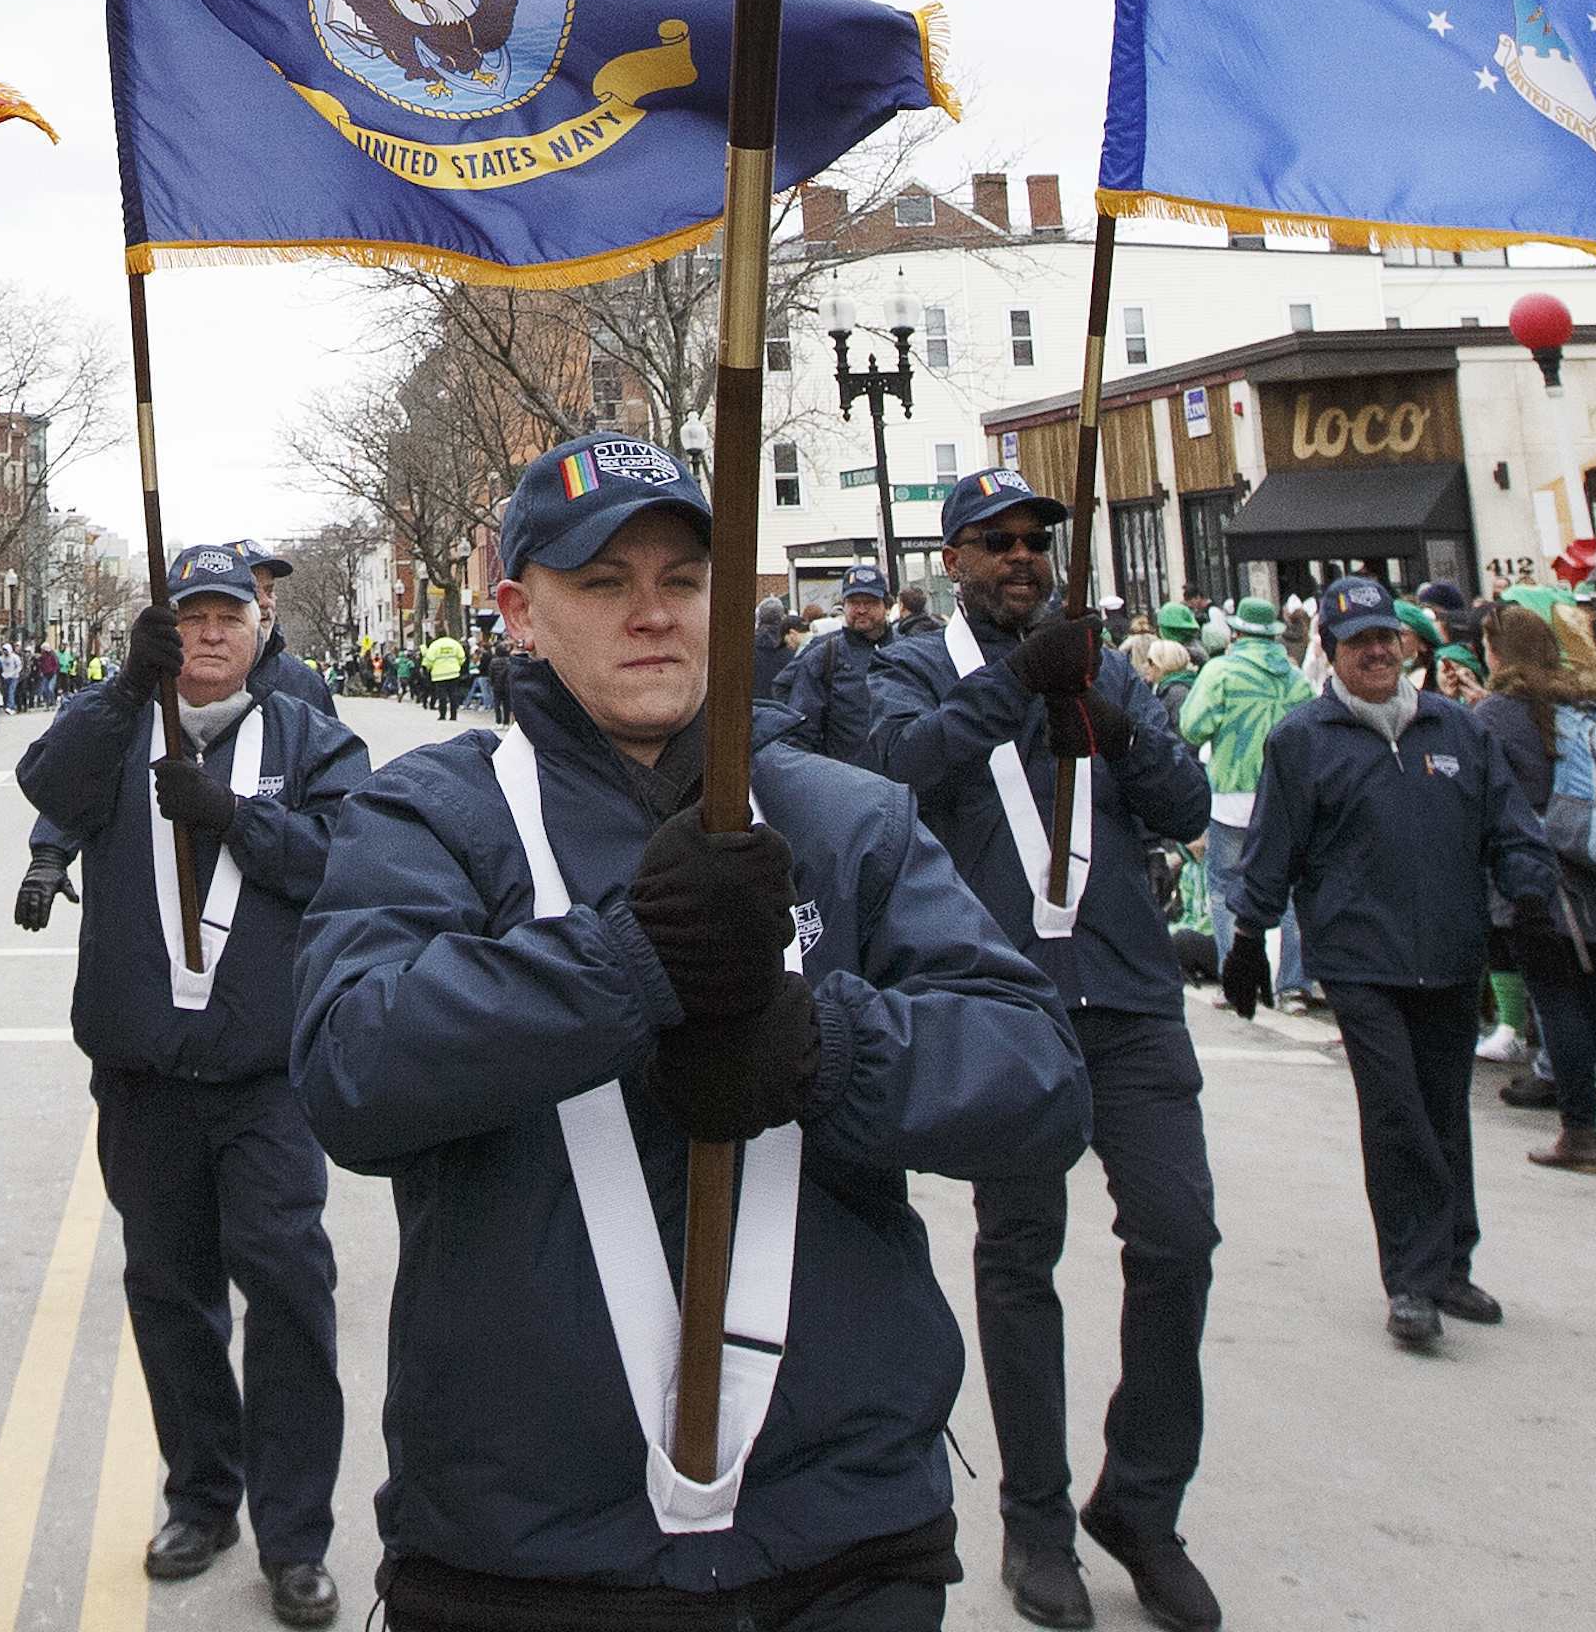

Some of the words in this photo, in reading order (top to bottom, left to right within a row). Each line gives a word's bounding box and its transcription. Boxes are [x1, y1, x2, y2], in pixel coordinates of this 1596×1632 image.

[356, 131, 437, 177] UNITED
[451, 146, 537, 179] STATES
[548, 111, 622, 163] NAVY
[1293, 392, 1431, 459] loco
[1486, 557, 1534, 576] 412
